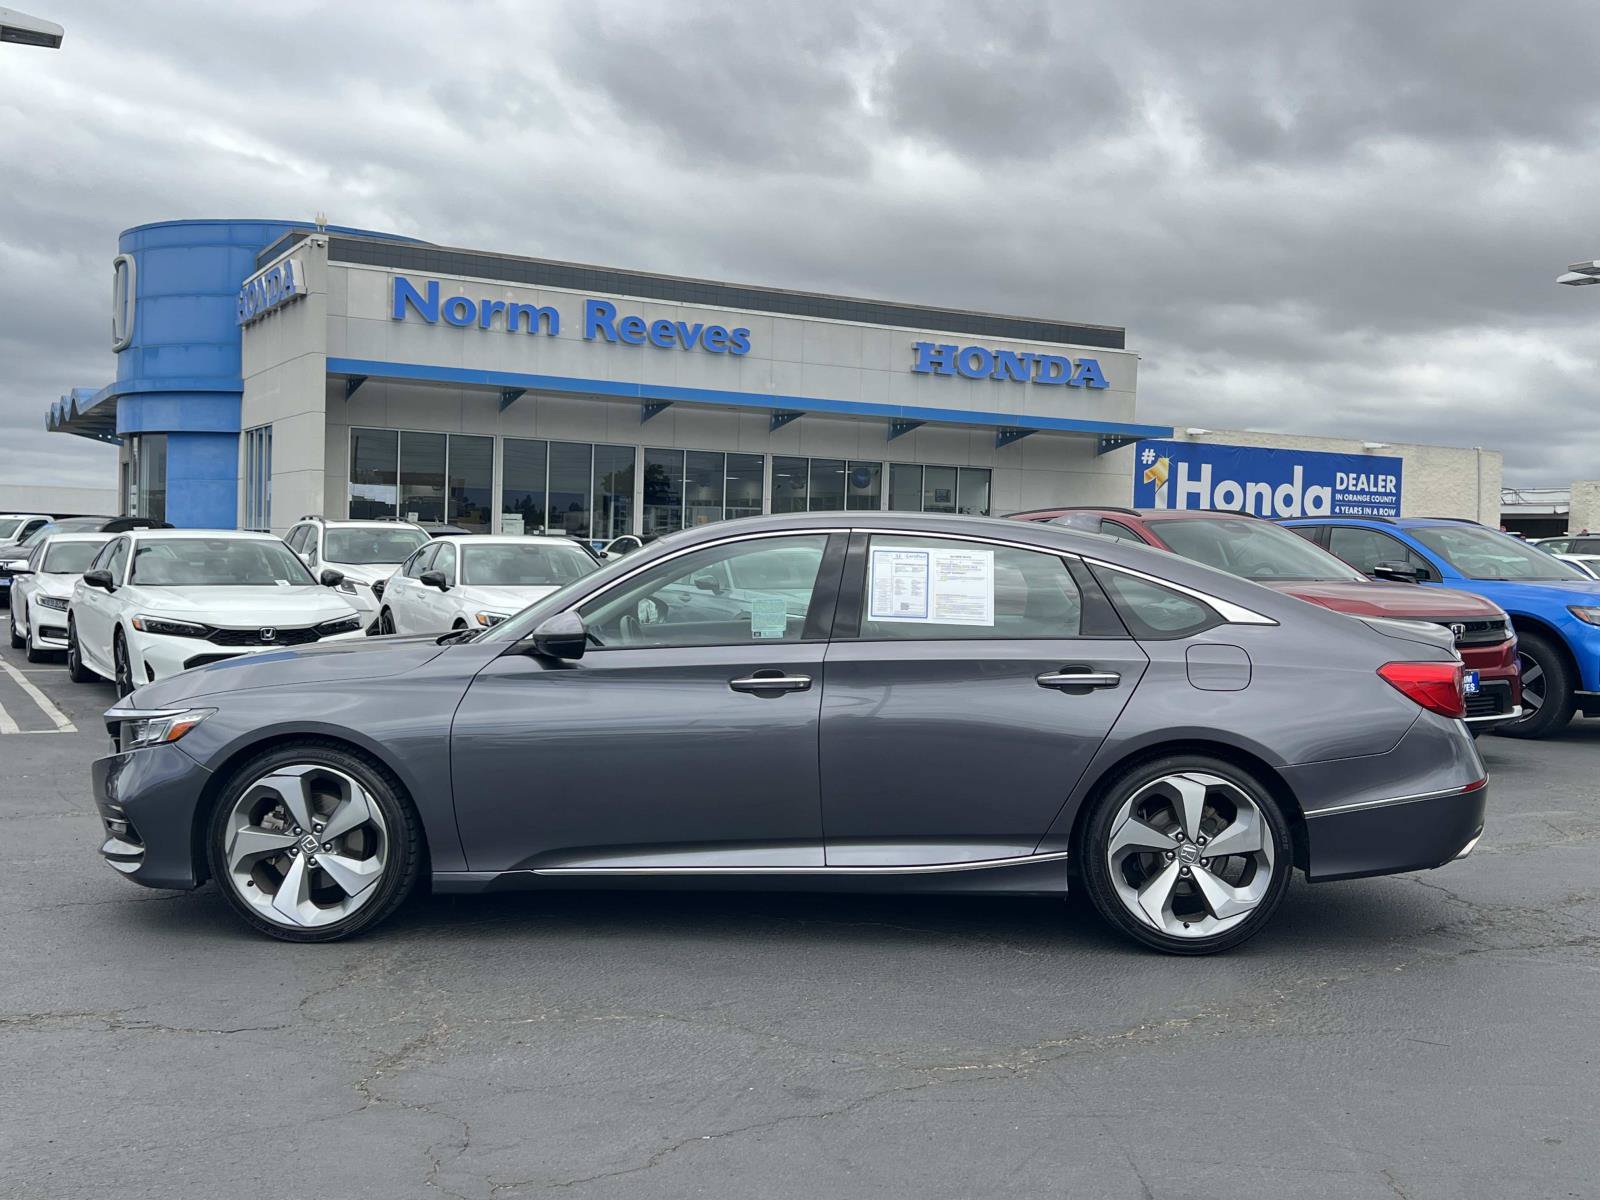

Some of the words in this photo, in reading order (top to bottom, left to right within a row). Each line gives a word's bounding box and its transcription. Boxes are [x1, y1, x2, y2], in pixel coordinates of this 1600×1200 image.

[236, 258, 296, 321] HONDA
[392, 276, 560, 337] Norm
[583, 299, 751, 356] Reeves
[911, 342, 1110, 389] HONDA
[1176, 461, 1332, 518] Honda
[1335, 493, 1343, 501] IN
[1343, 493, 1370, 502] ORANGE
[1371, 495, 1397, 503] COUNTY
[1336, 472, 1397, 493] DEALER
[1335, 506, 1340, 514] 4
[1341, 506, 1363, 515] YEARS
[1363, 507, 1372, 515] IN
[1372, 508, 1378, 516] A
[1379, 508, 1396, 516] ROW
